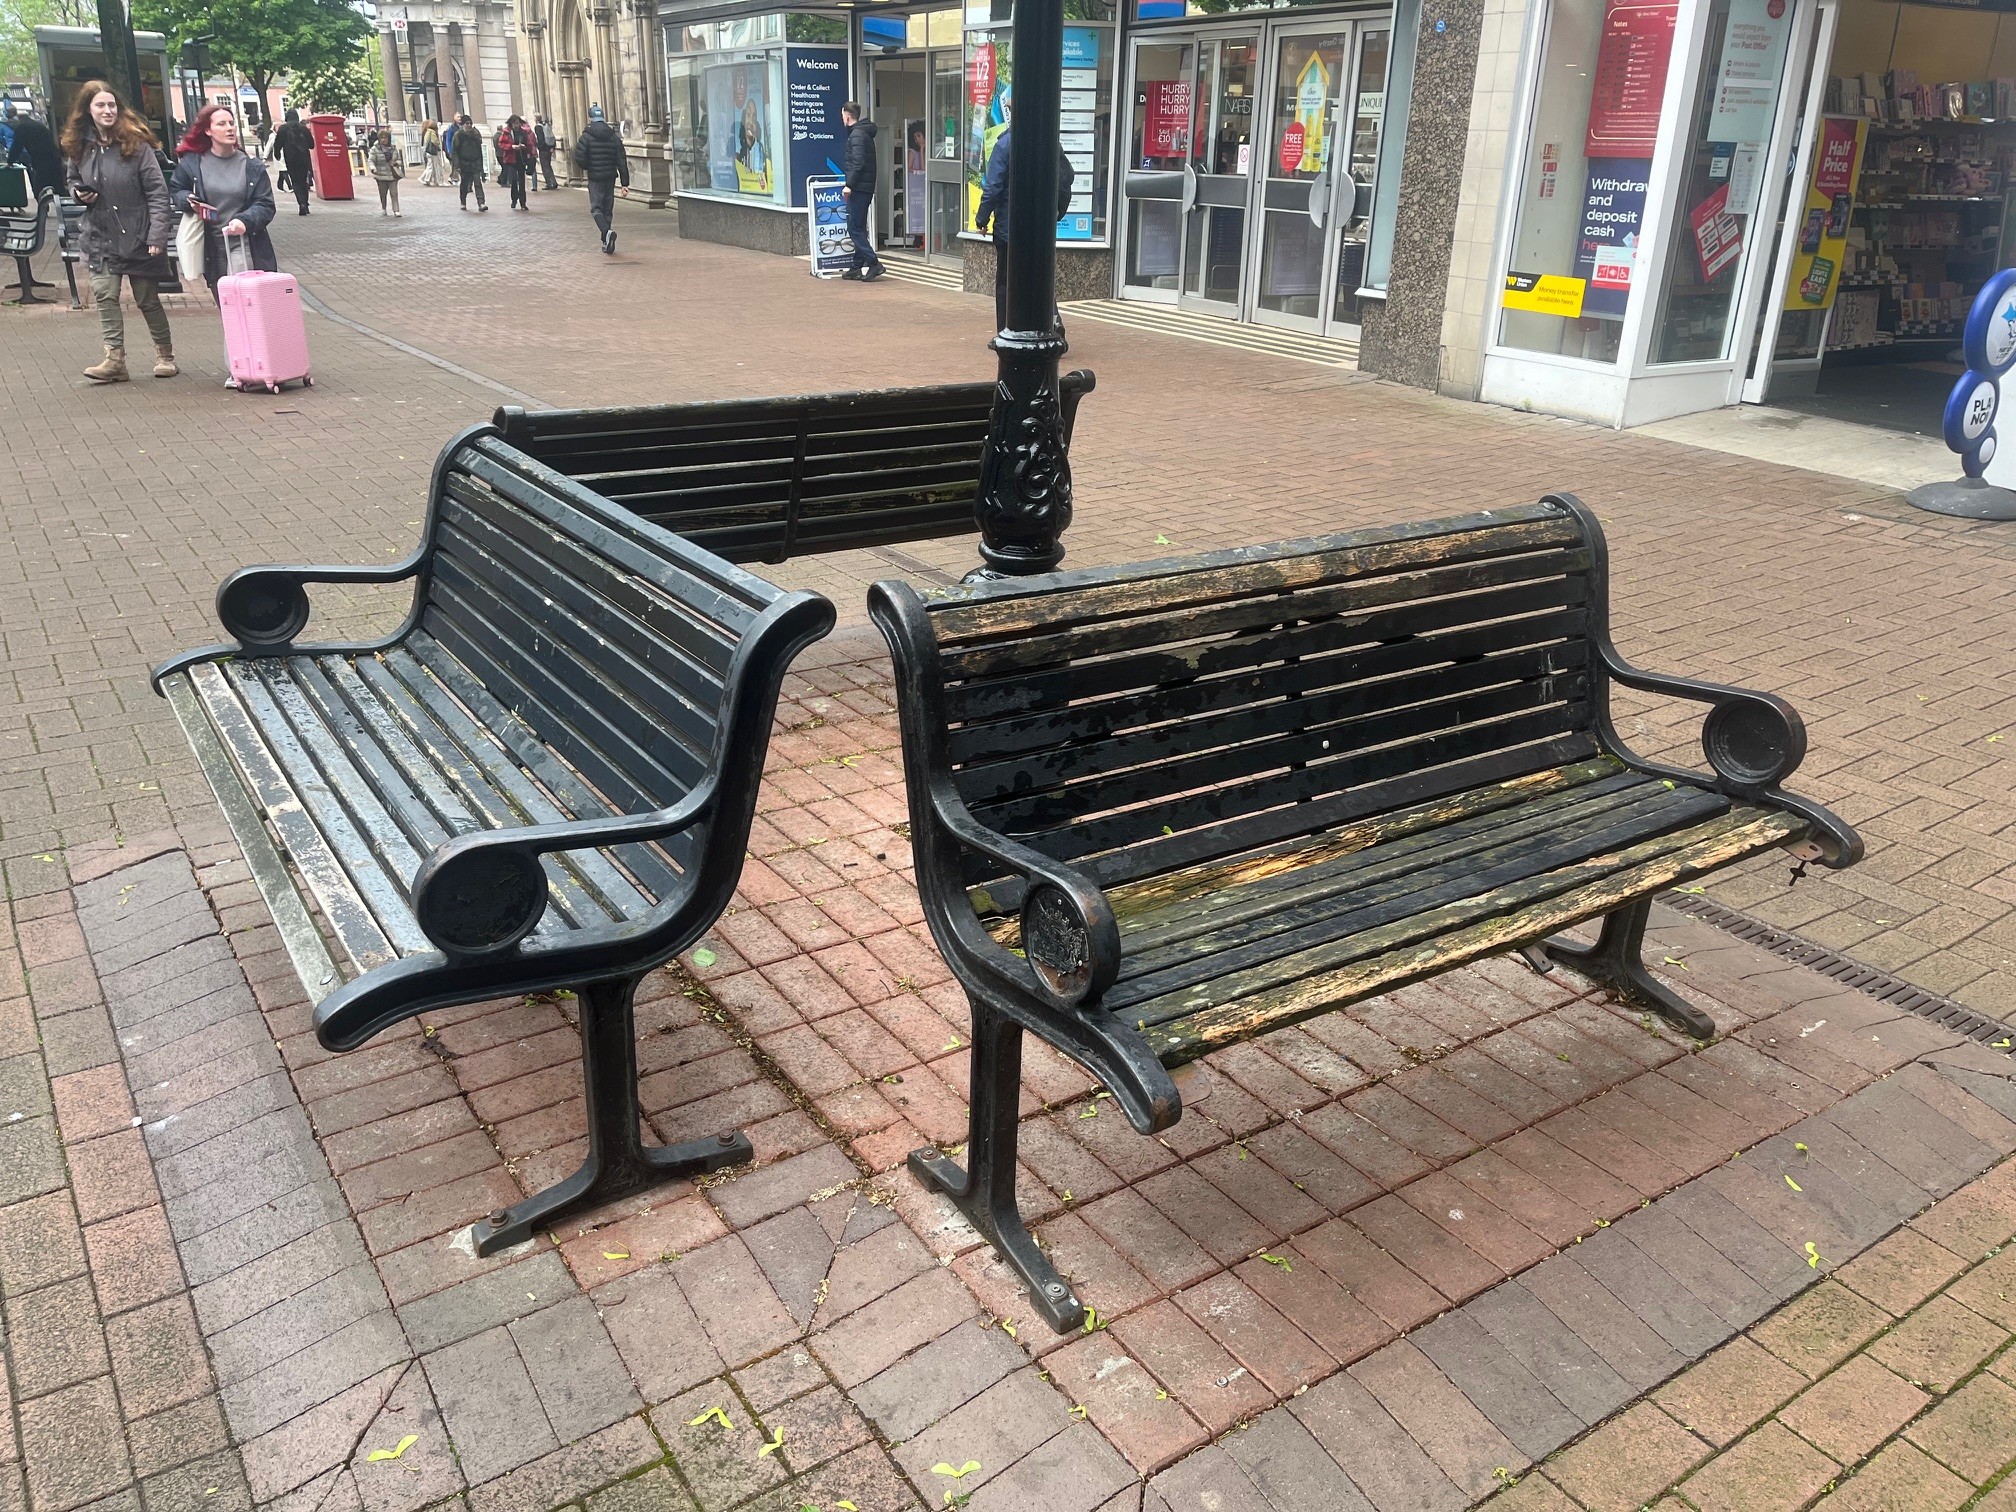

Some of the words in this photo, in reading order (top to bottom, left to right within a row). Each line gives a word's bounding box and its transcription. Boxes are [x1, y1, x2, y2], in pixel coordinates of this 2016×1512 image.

[797, 59, 838, 69] Welcome
[1162, 84, 1191, 94] HURRY
[1161, 95, 1190, 104] HURRY
[1160, 105, 1190, 114] HURRY
[1225, 99, 1251, 113] NARS
[1286, 134, 1302, 143] FREE
[1828, 140, 1852, 156] Half
[1823, 157, 1848, 172] Price
[815, 192, 840, 202] Work
[1589, 194, 1613, 206] and
[1587, 209, 1638, 223] deposit
[820, 226, 826, 236] &
[829, 226, 848, 238] play
[1585, 225, 1614, 237] cash
[1810, 275, 1826, 284] EASY
